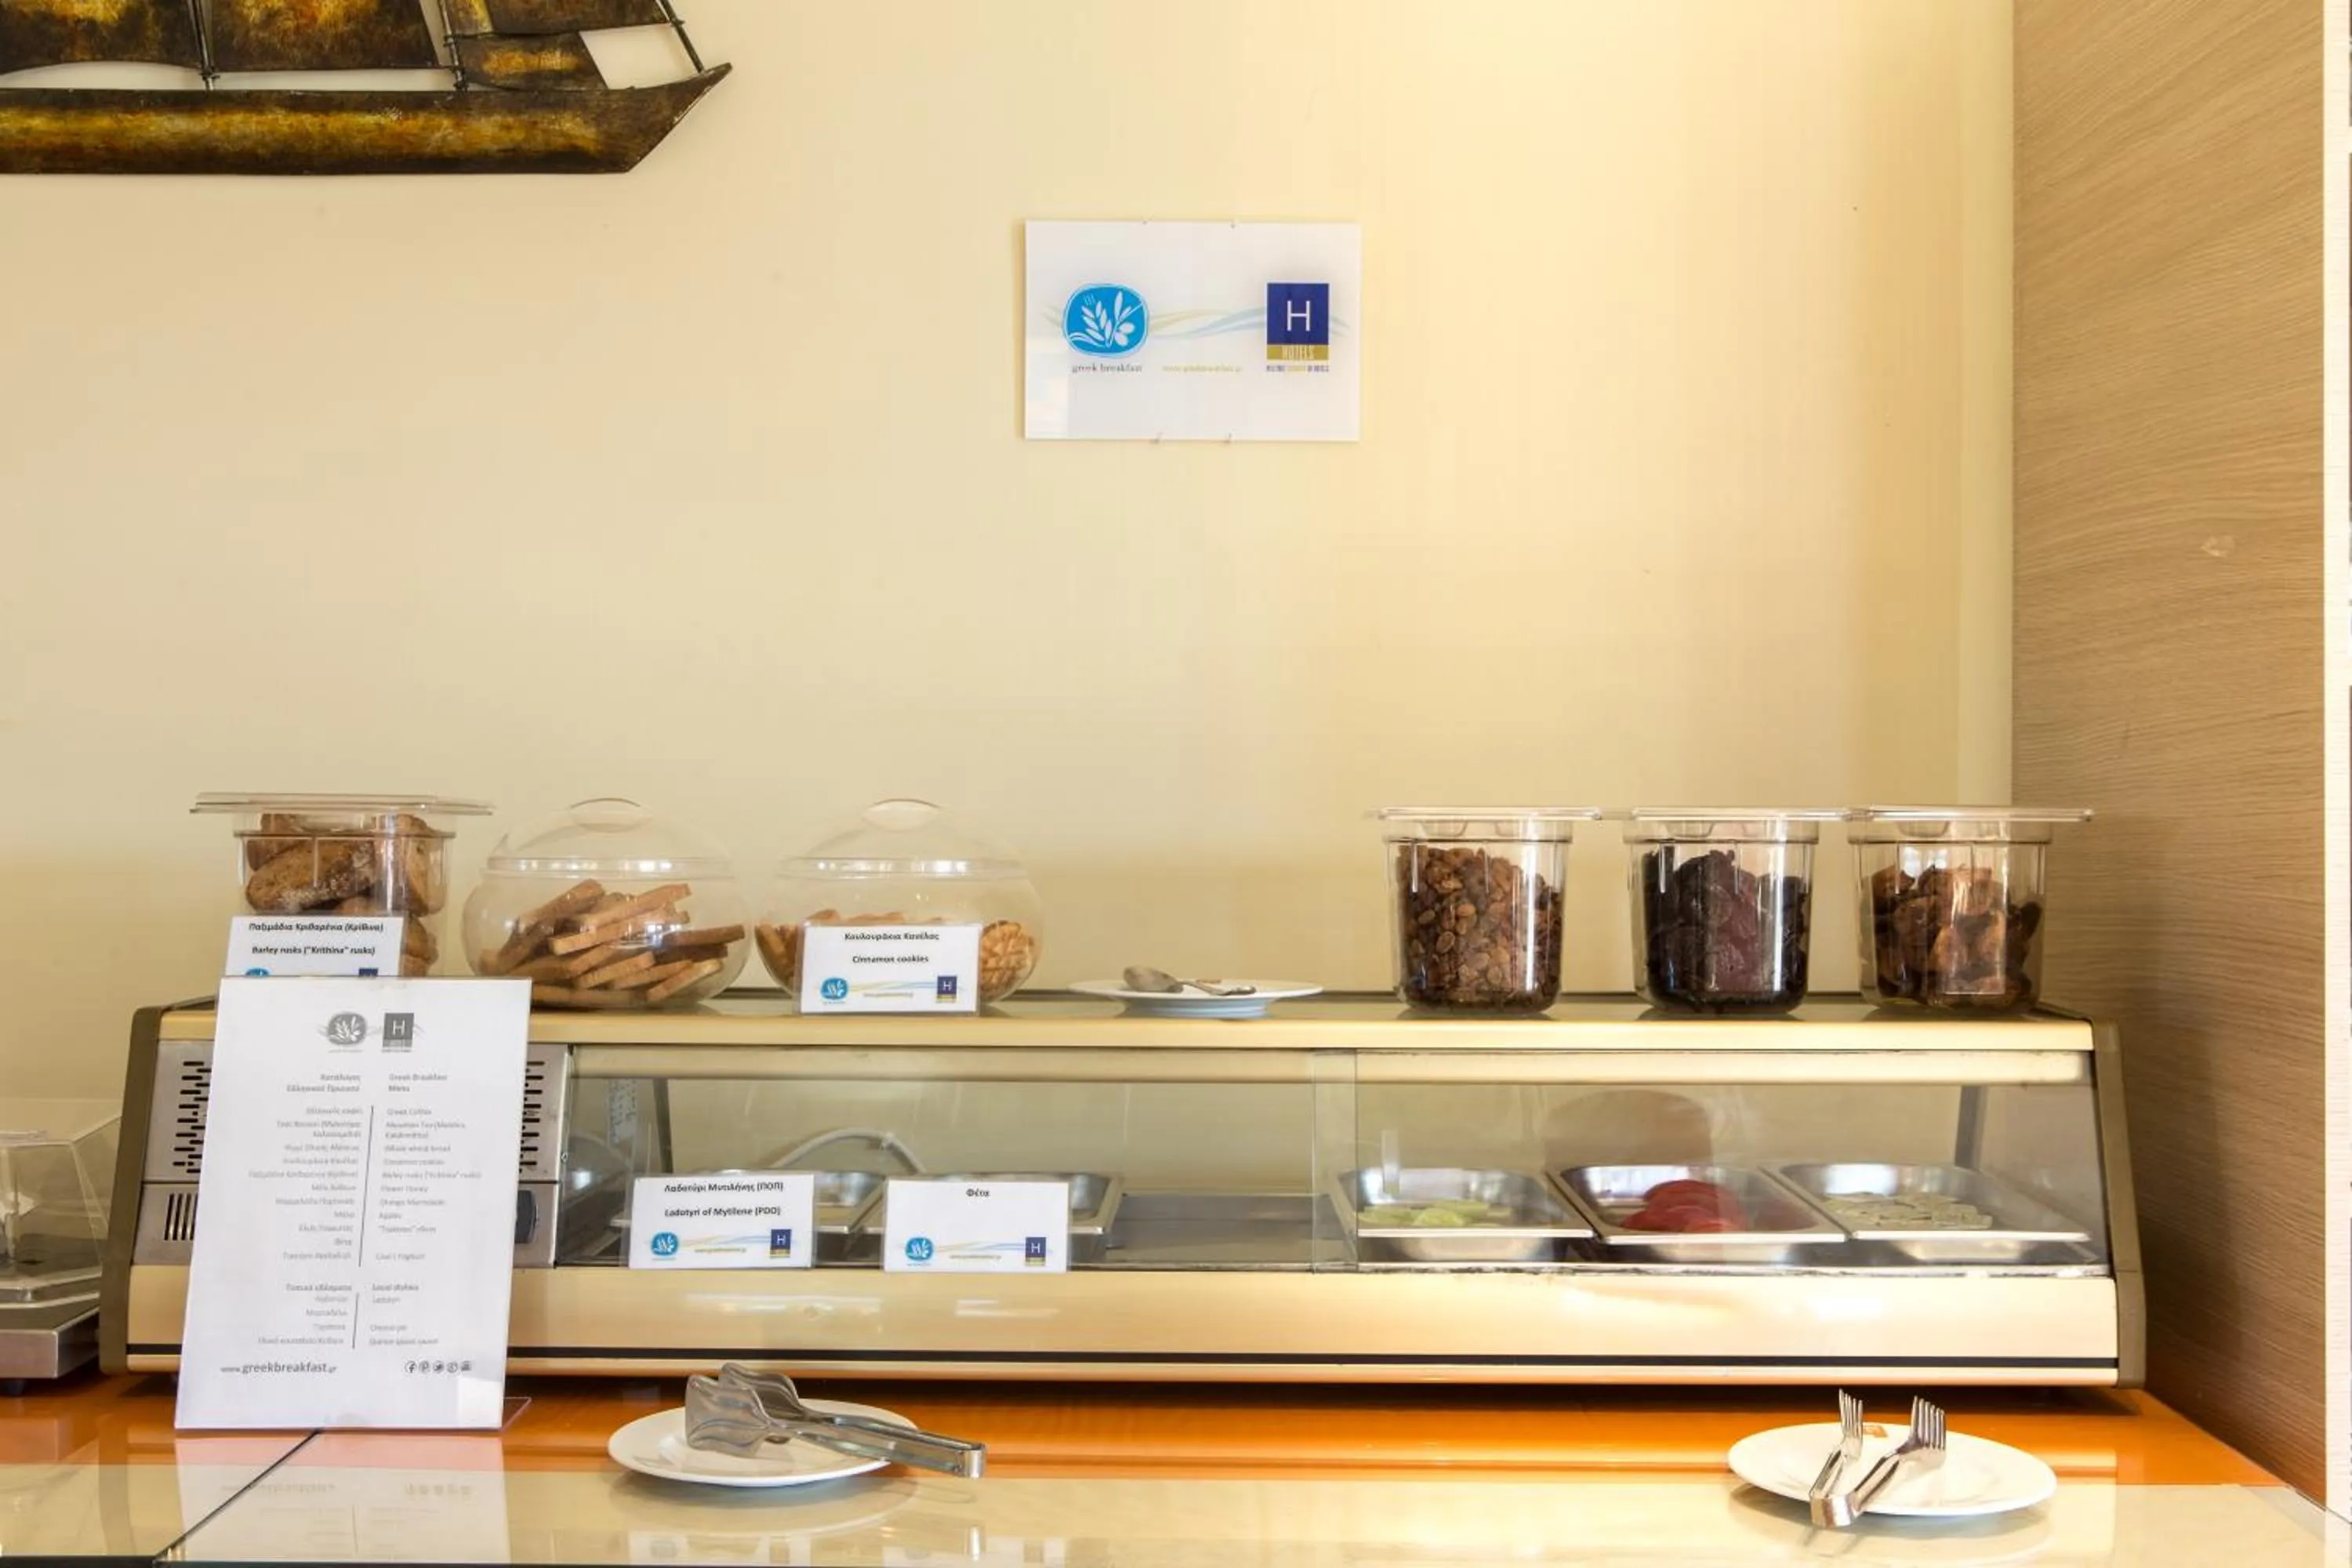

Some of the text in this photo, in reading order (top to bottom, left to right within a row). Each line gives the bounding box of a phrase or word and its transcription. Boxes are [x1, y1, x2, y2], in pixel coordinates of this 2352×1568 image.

[1287, 299, 1311, 332] H
[1072, 362, 1143, 373] greek breakfast
[249, 923, 292, 932] Παξιμάδια
[252, 946, 278, 955] Barley
[350, 946, 376, 956] rusks)
[852, 954, 929, 964] Cinnamon cookies
[942, 981, 953, 992] H
[393, 1018, 405, 1036] H
[664, 1182, 706, 1192] Λαδοτύρι
[757, 1181, 784, 1192] (ΠΟΠ)
[966, 1187, 990, 1198] Φέτα
[664, 1208, 700, 1218] Ladotyri
[702, 1207, 712, 1216] of
[755, 1206, 782, 1217] (PDO)
[776, 1235, 786, 1245] H
[1031, 1243, 1041, 1254] H
